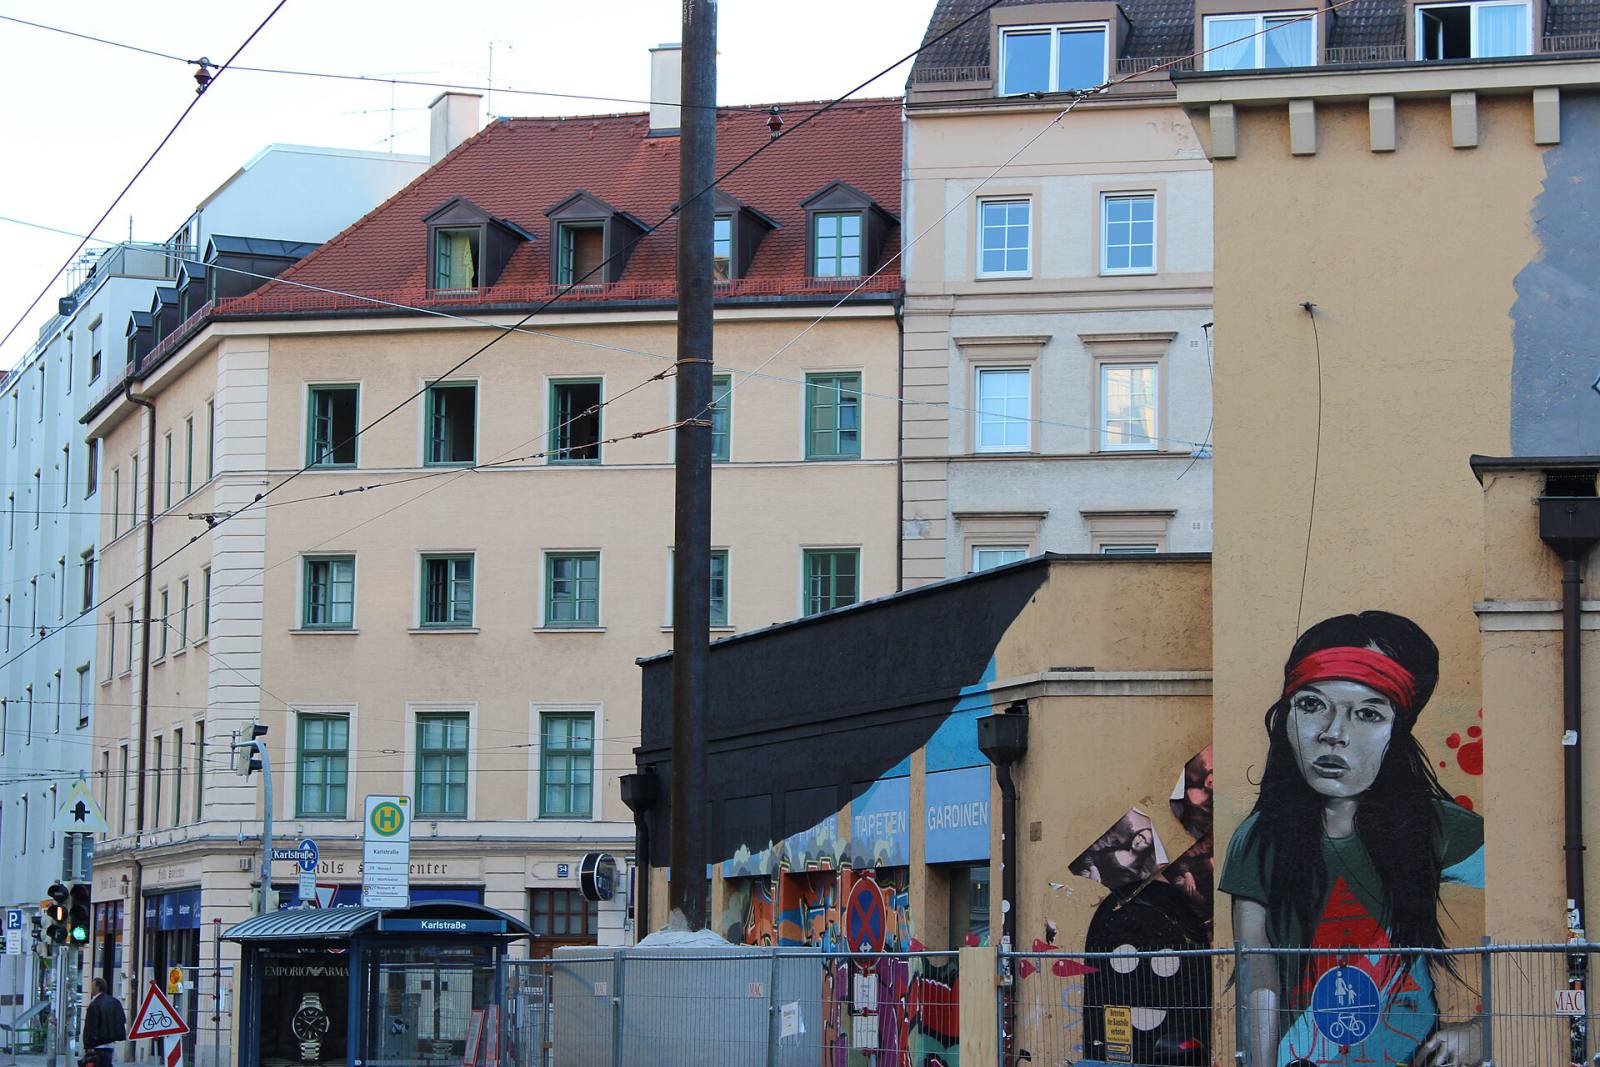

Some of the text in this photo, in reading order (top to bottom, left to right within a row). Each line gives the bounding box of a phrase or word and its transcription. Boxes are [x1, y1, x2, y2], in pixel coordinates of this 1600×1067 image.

[855, 810, 906, 837] TAPETEN
[927, 801, 988, 830] GARDINEN
[273, 849, 315, 860] Karlstraße
[8, 912, 18, 928] P
[421, 920, 467, 929] Karlstraße
[264, 966, 350, 977] EMPORIO ARMA
[1555, 991, 1583, 1011] MAC
